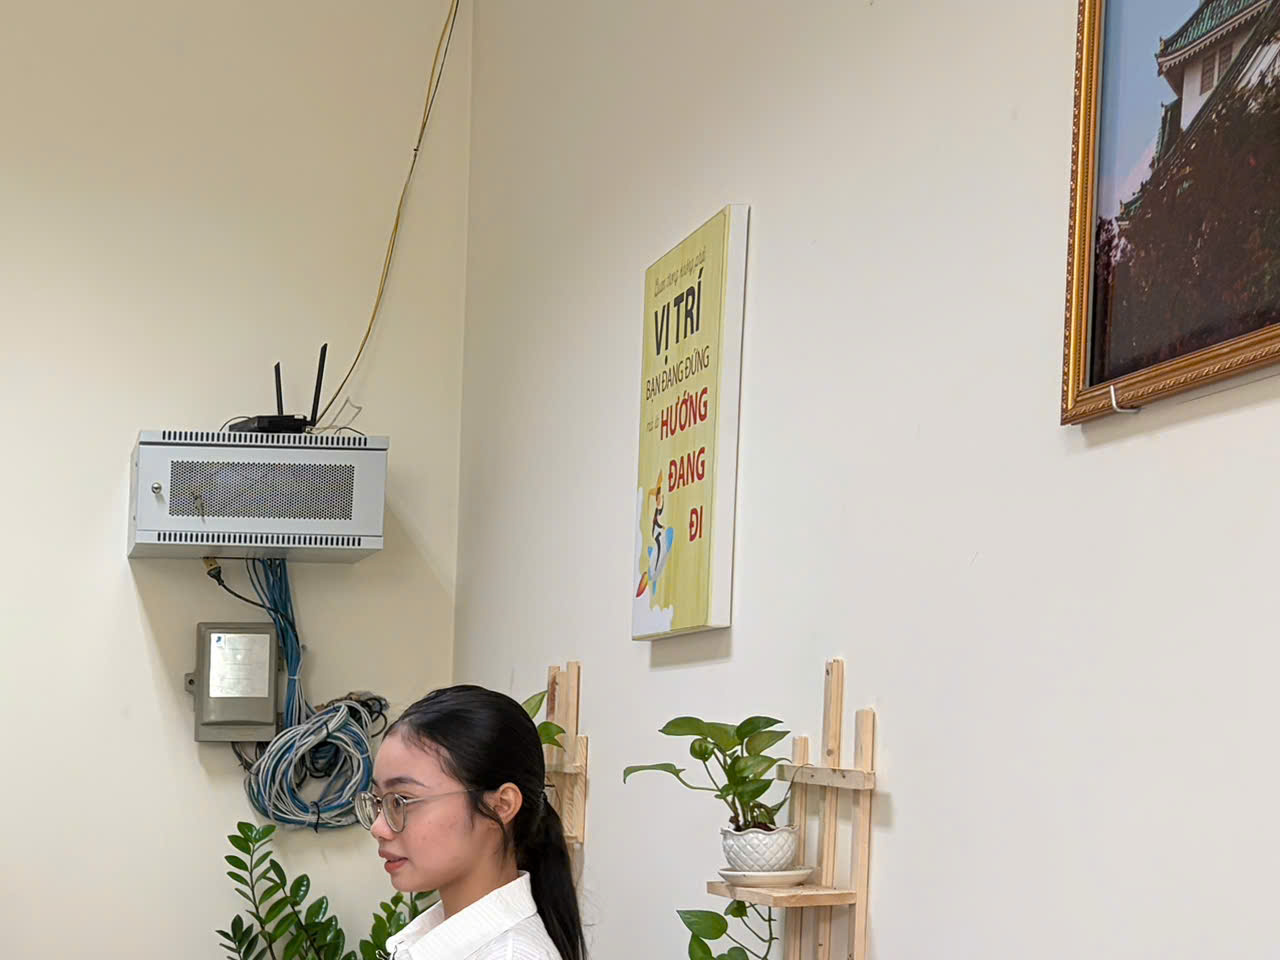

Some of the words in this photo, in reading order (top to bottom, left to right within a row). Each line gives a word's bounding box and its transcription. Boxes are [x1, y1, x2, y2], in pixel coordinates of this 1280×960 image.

[654, 301, 670, 366] VỊ
[673, 266, 704, 345] TRÍ
[660, 386, 708, 441] HƯỚNG
[668, 446, 706, 493] ĐANG
[689, 505, 703, 542] ĐI
